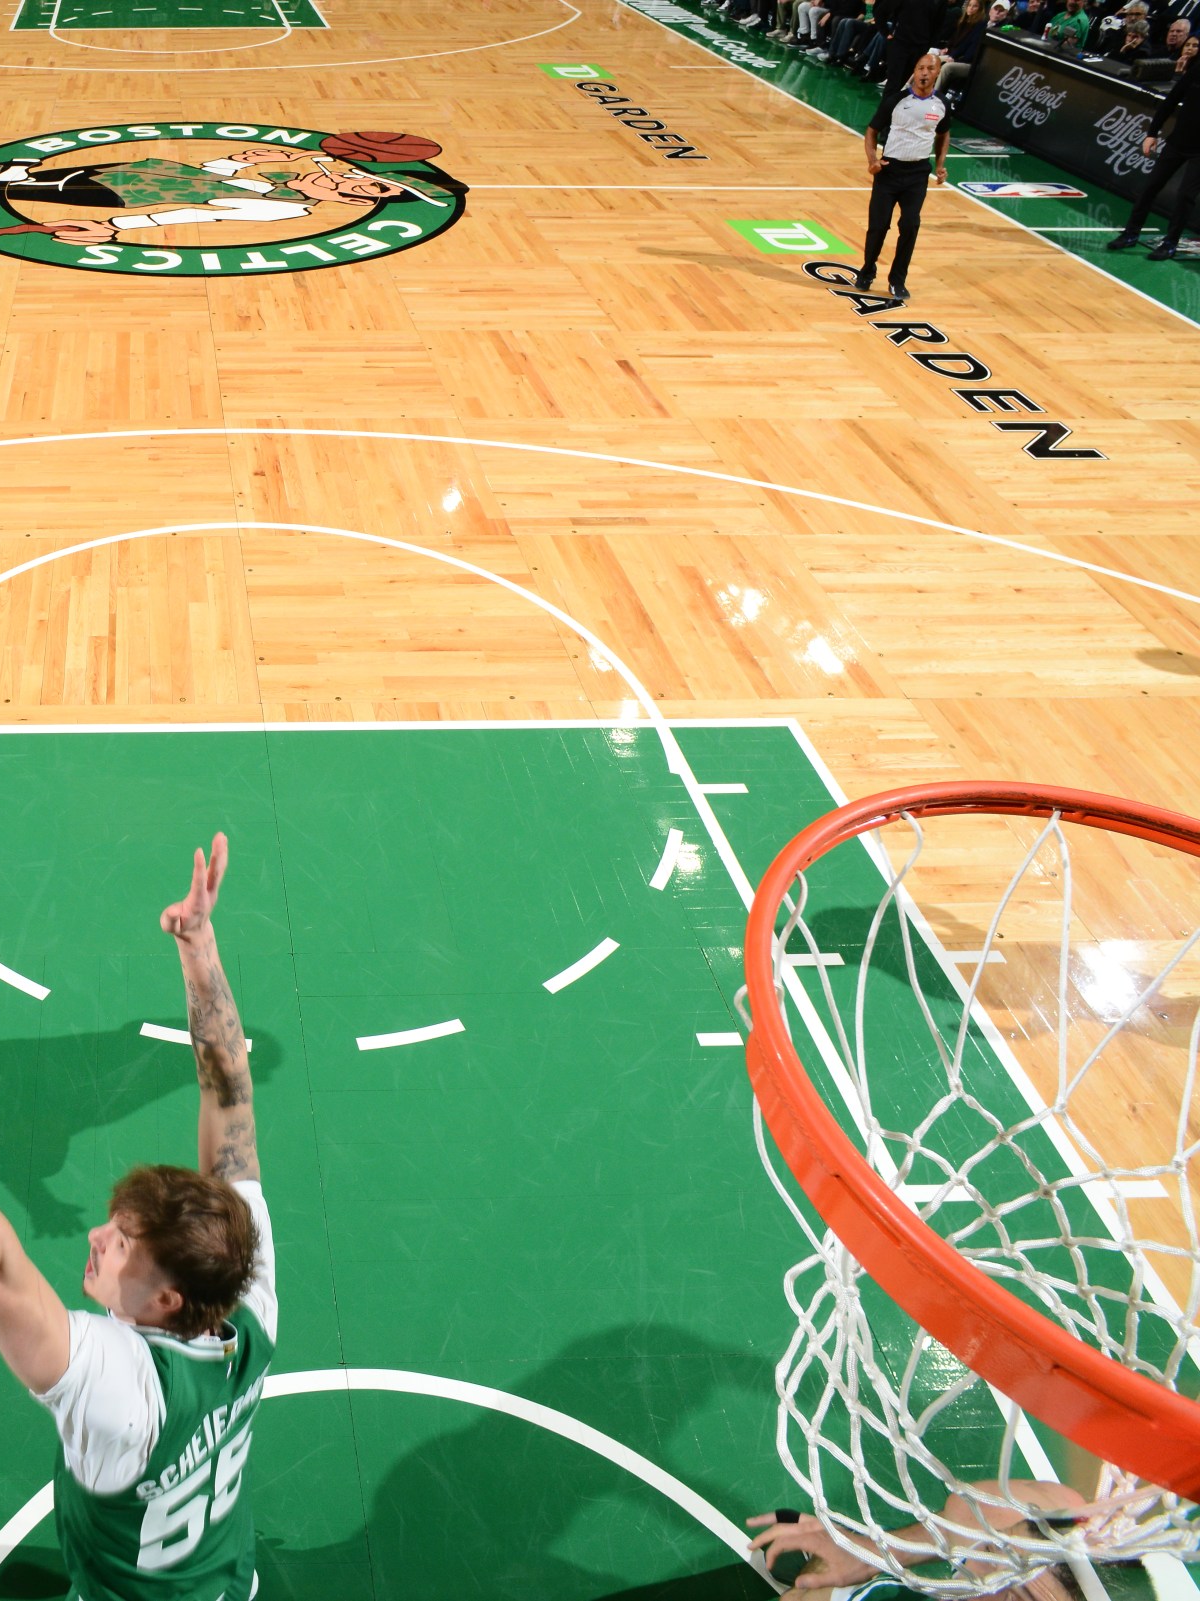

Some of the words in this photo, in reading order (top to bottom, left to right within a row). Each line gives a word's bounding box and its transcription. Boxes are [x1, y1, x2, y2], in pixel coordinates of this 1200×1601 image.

[553, 64, 600, 78] TD
[712, 40, 781, 69] Google
[996, 66, 1067, 110] Different
[575, 82, 711, 160] GARDEN
[1002, 92, 1051, 128] Here
[25, 124, 312, 152] BOSTON
[1100, 134, 1156, 176] Here
[77, 220, 423, 270] CELTICS
[753, 222, 829, 251] TD
[800, 260, 1110, 460] GARDEN
[136, 1403, 260, 1573] 55
